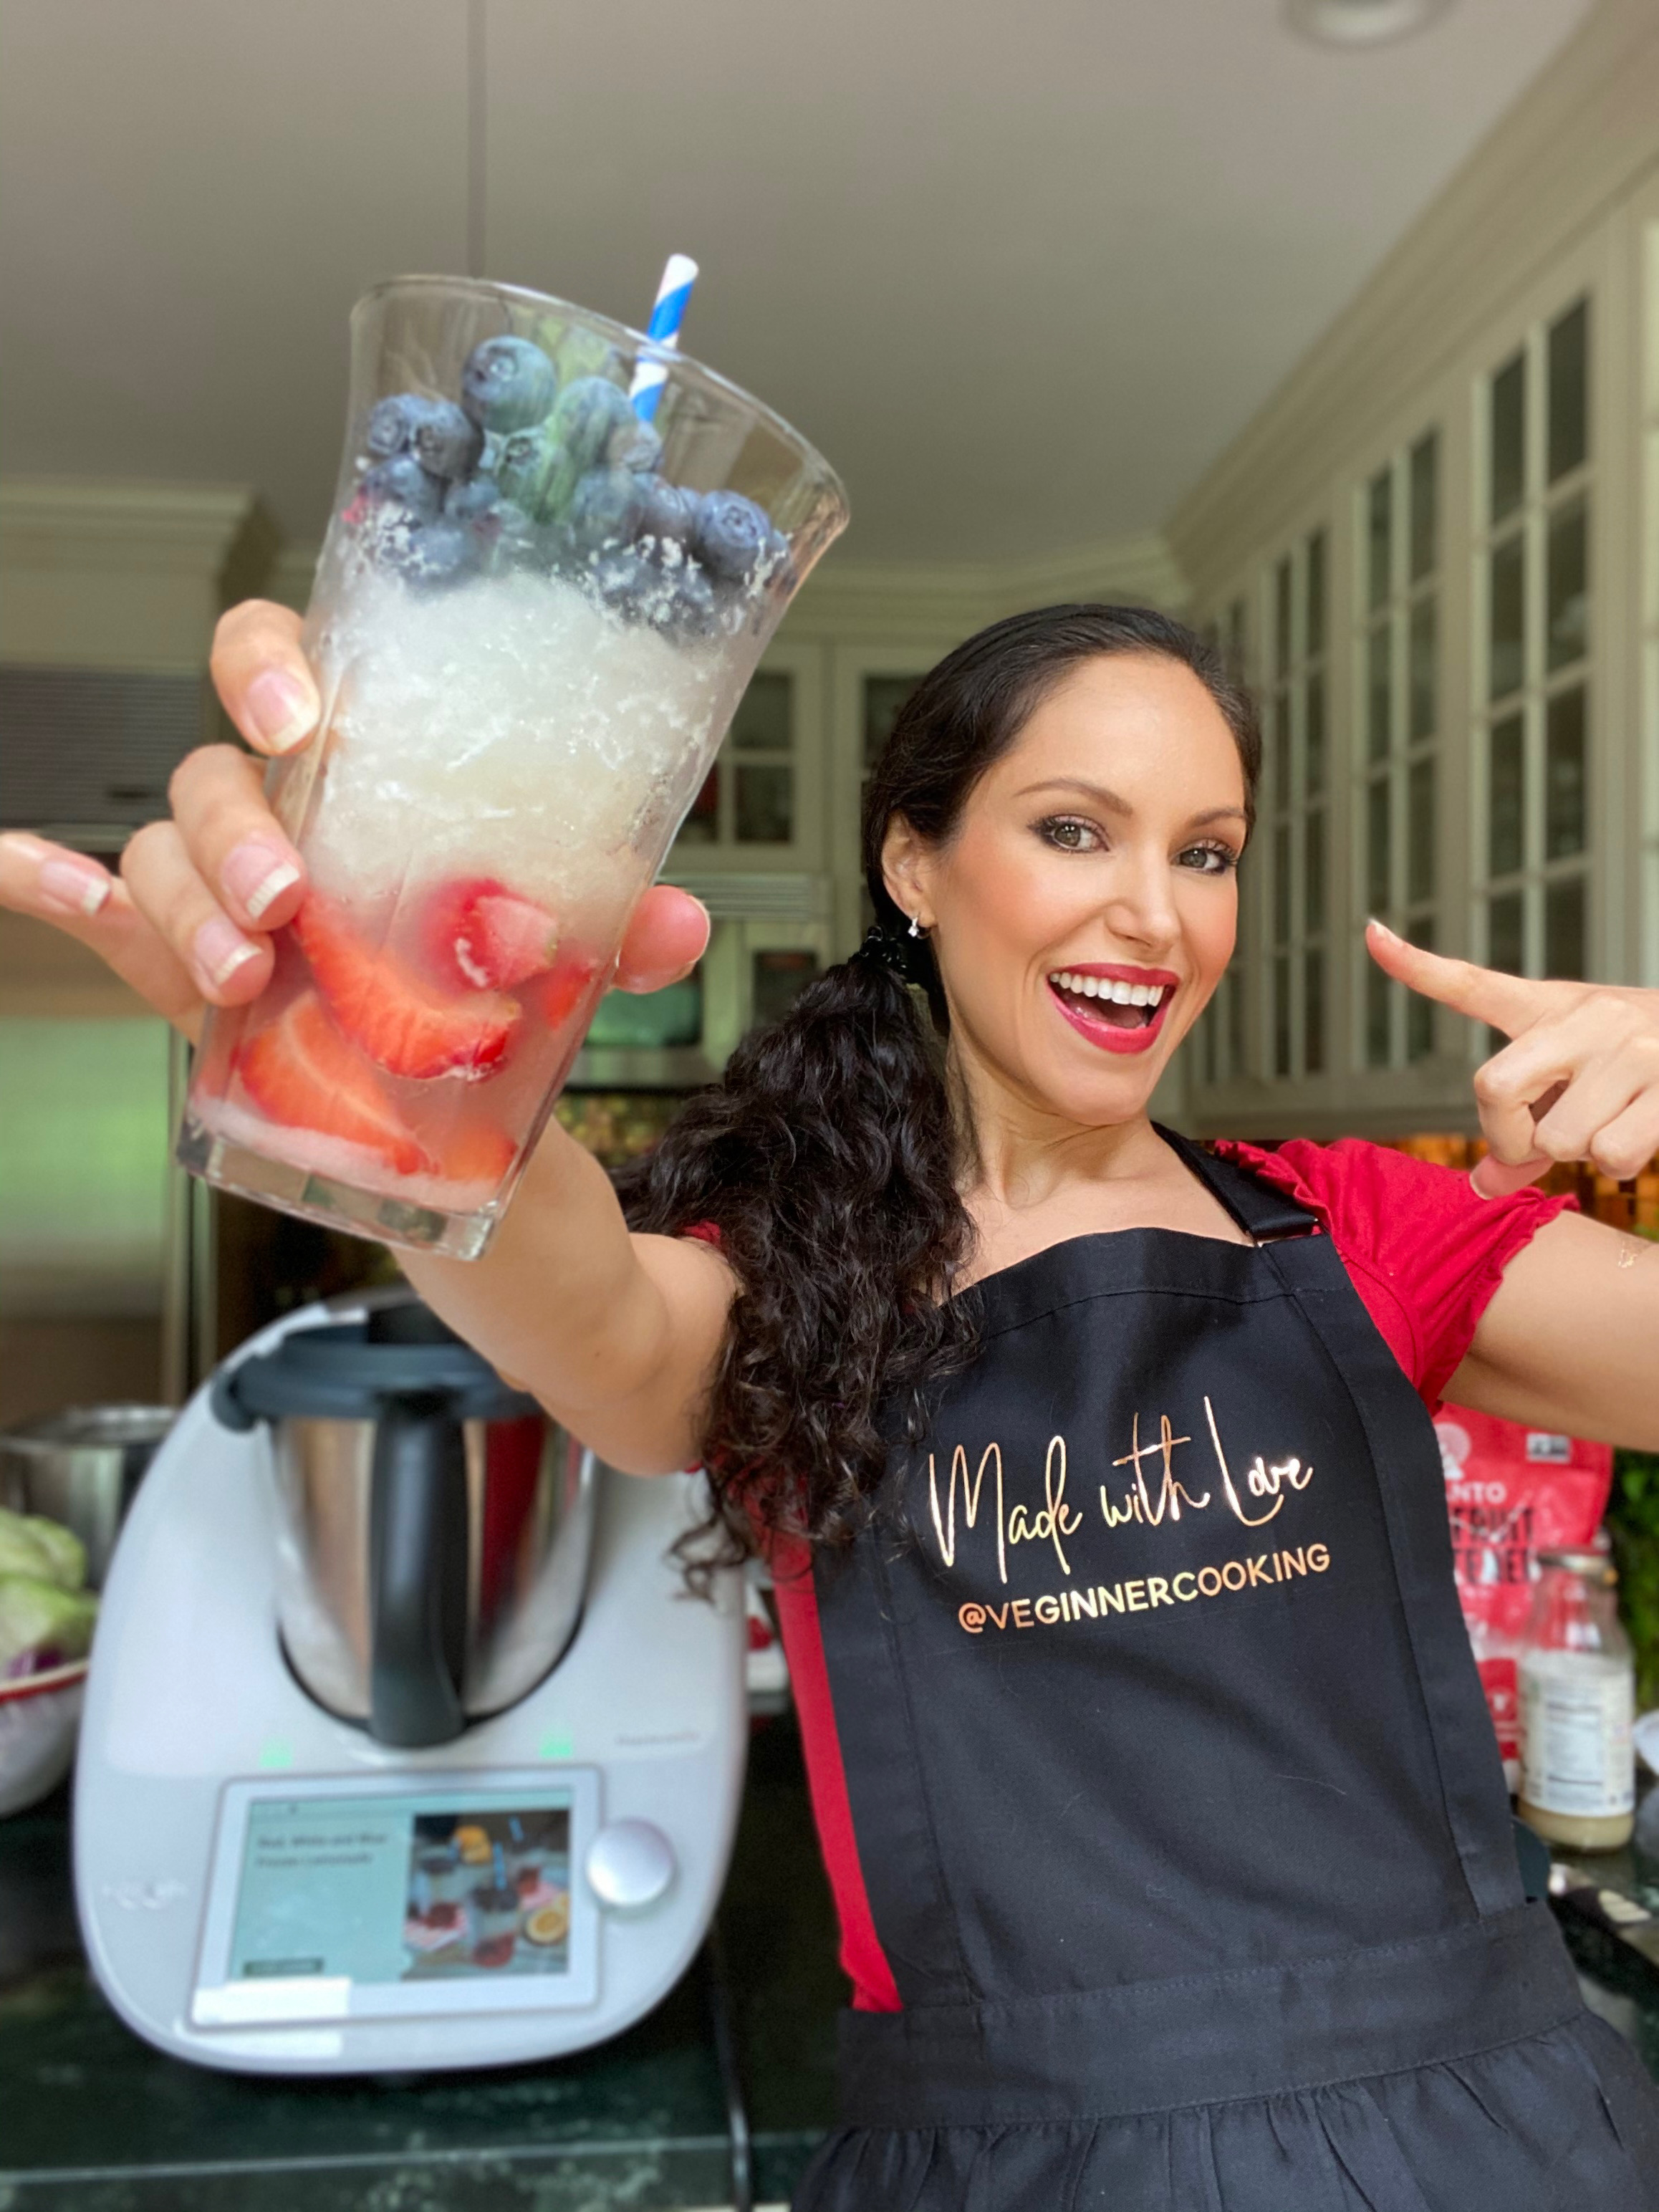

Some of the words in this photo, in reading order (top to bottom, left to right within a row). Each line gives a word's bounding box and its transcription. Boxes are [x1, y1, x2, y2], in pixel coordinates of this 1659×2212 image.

[929, 1435, 1082, 1584] Made
[1101, 1412, 1211, 1526] with
[1204, 1396, 1313, 1526] Love
[958, 1543, 1330, 1633] @VEGINNERCOOKING
